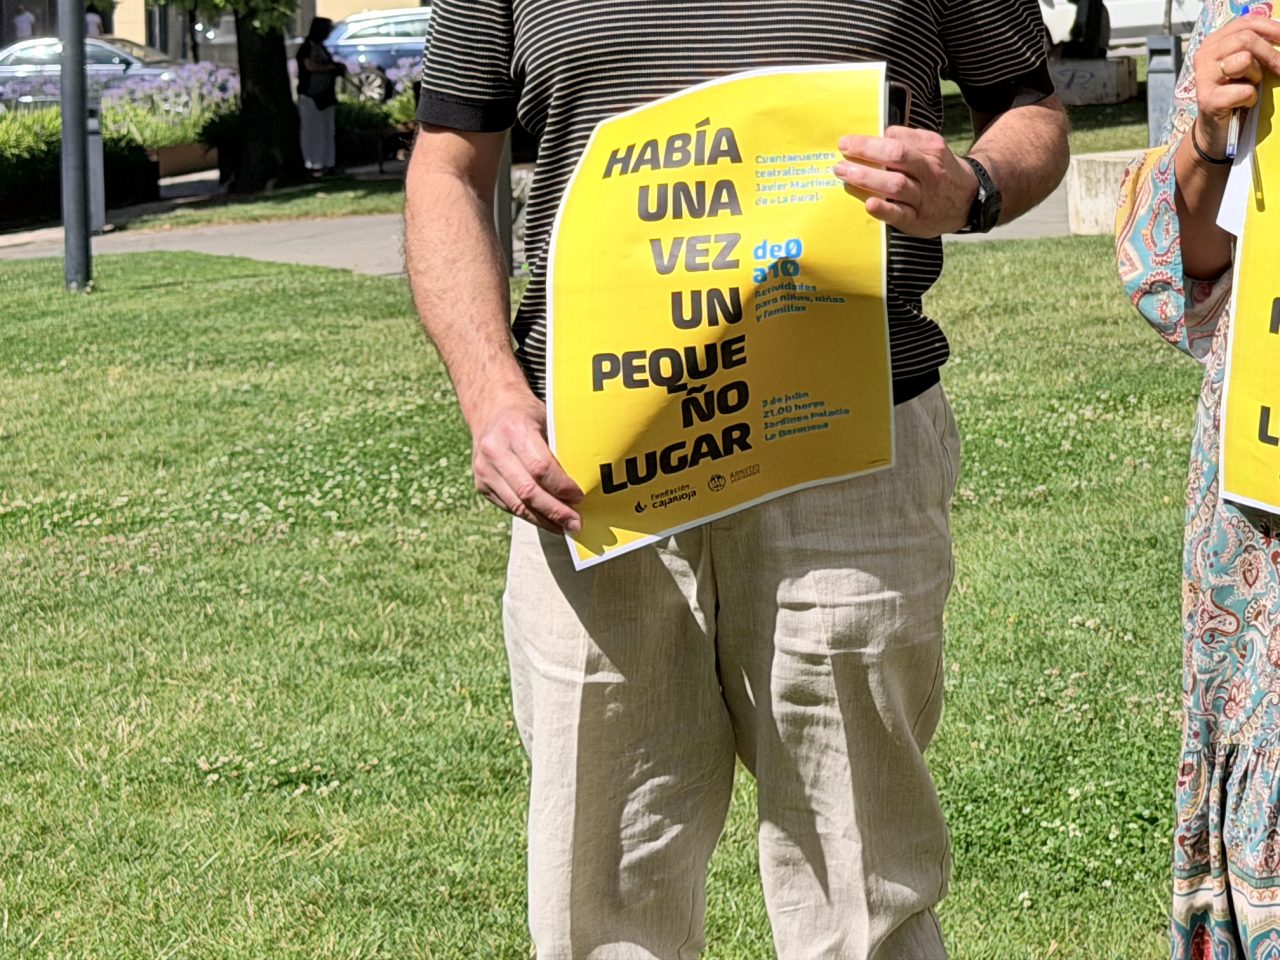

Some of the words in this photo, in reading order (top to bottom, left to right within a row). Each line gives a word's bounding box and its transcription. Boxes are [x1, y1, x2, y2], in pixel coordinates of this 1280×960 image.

[602, 117, 742, 179] HABÍA
[637, 180, 742, 222] UNA
[650, 233, 741, 275] VEZ
[671, 287, 743, 330] UN
[592, 335, 746, 394] PEQUE
[681, 380, 749, 428] ÑO
[600, 422, 753, 495] LUGAR
